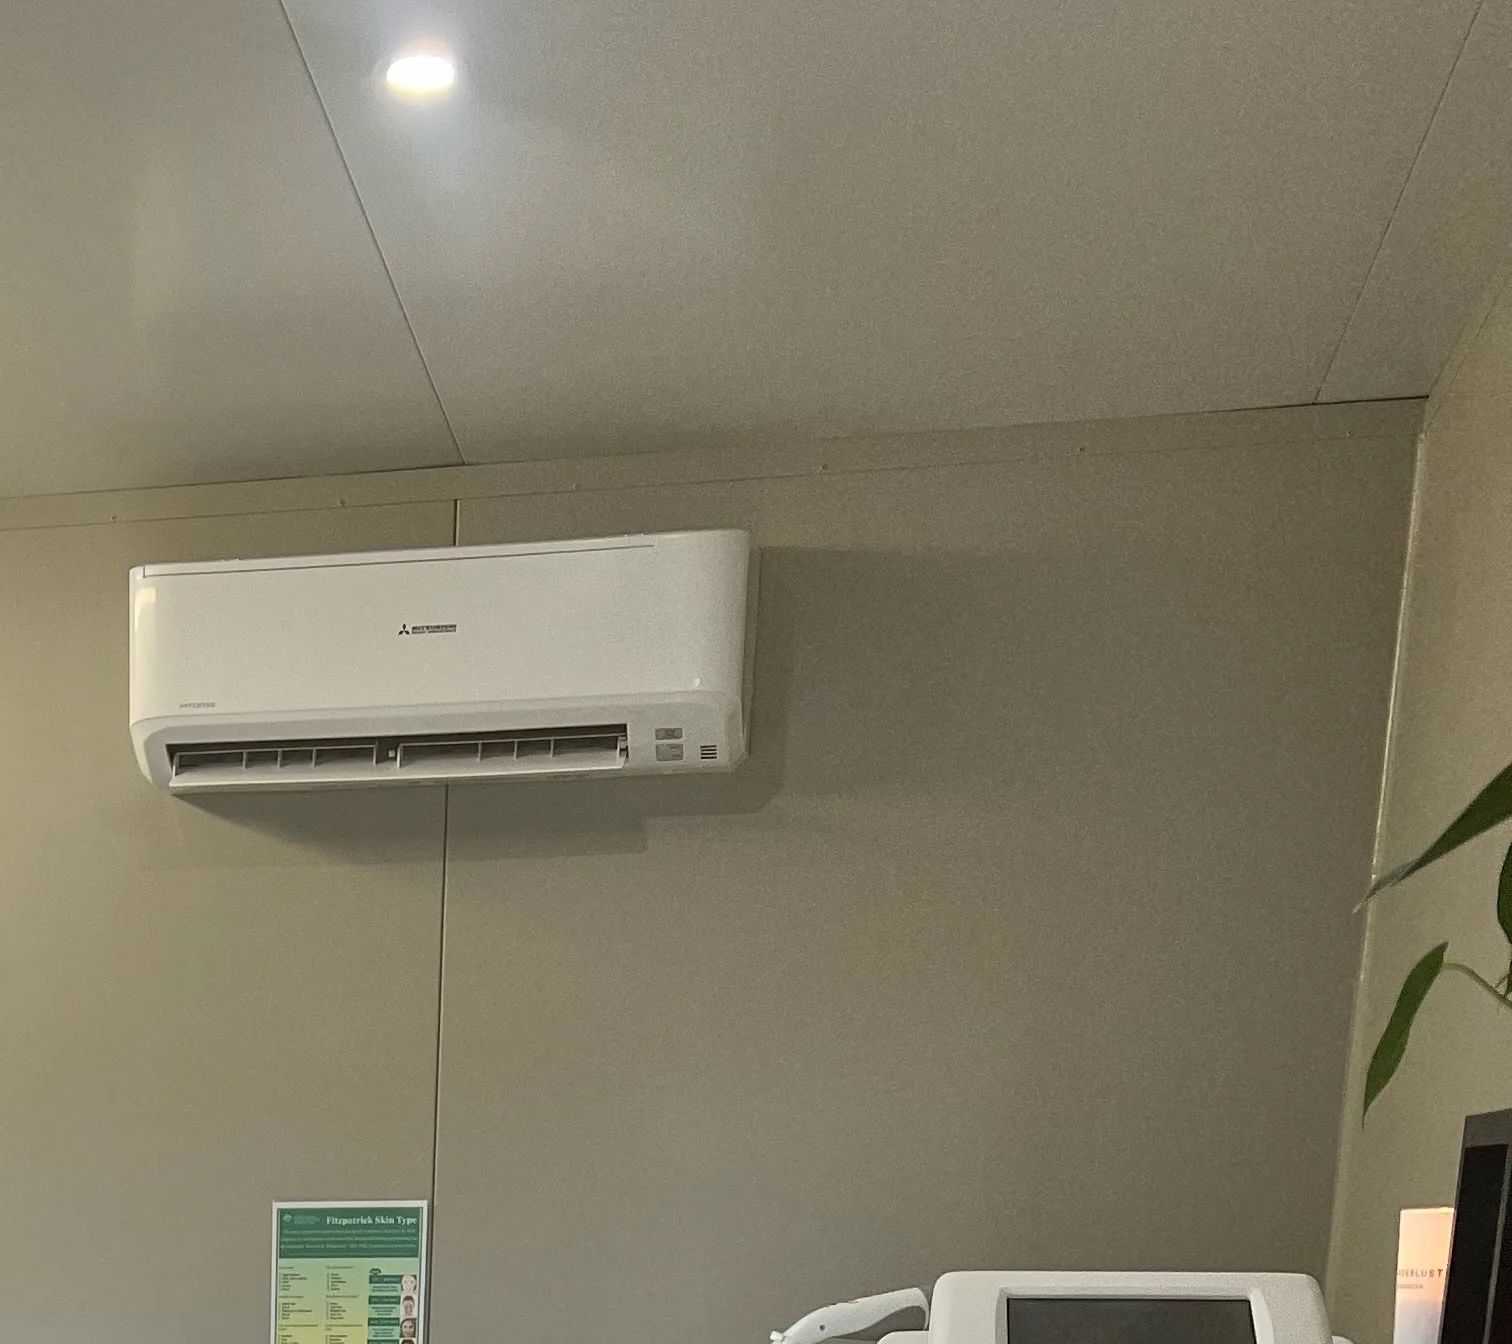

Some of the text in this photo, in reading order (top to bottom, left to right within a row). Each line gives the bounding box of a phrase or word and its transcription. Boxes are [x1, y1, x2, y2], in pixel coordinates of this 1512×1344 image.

[326, 1215, 373, 1226] Fitzpatrick
[375, 1215, 395, 1225] Skin
[396, 1215, 418, 1226] Type
